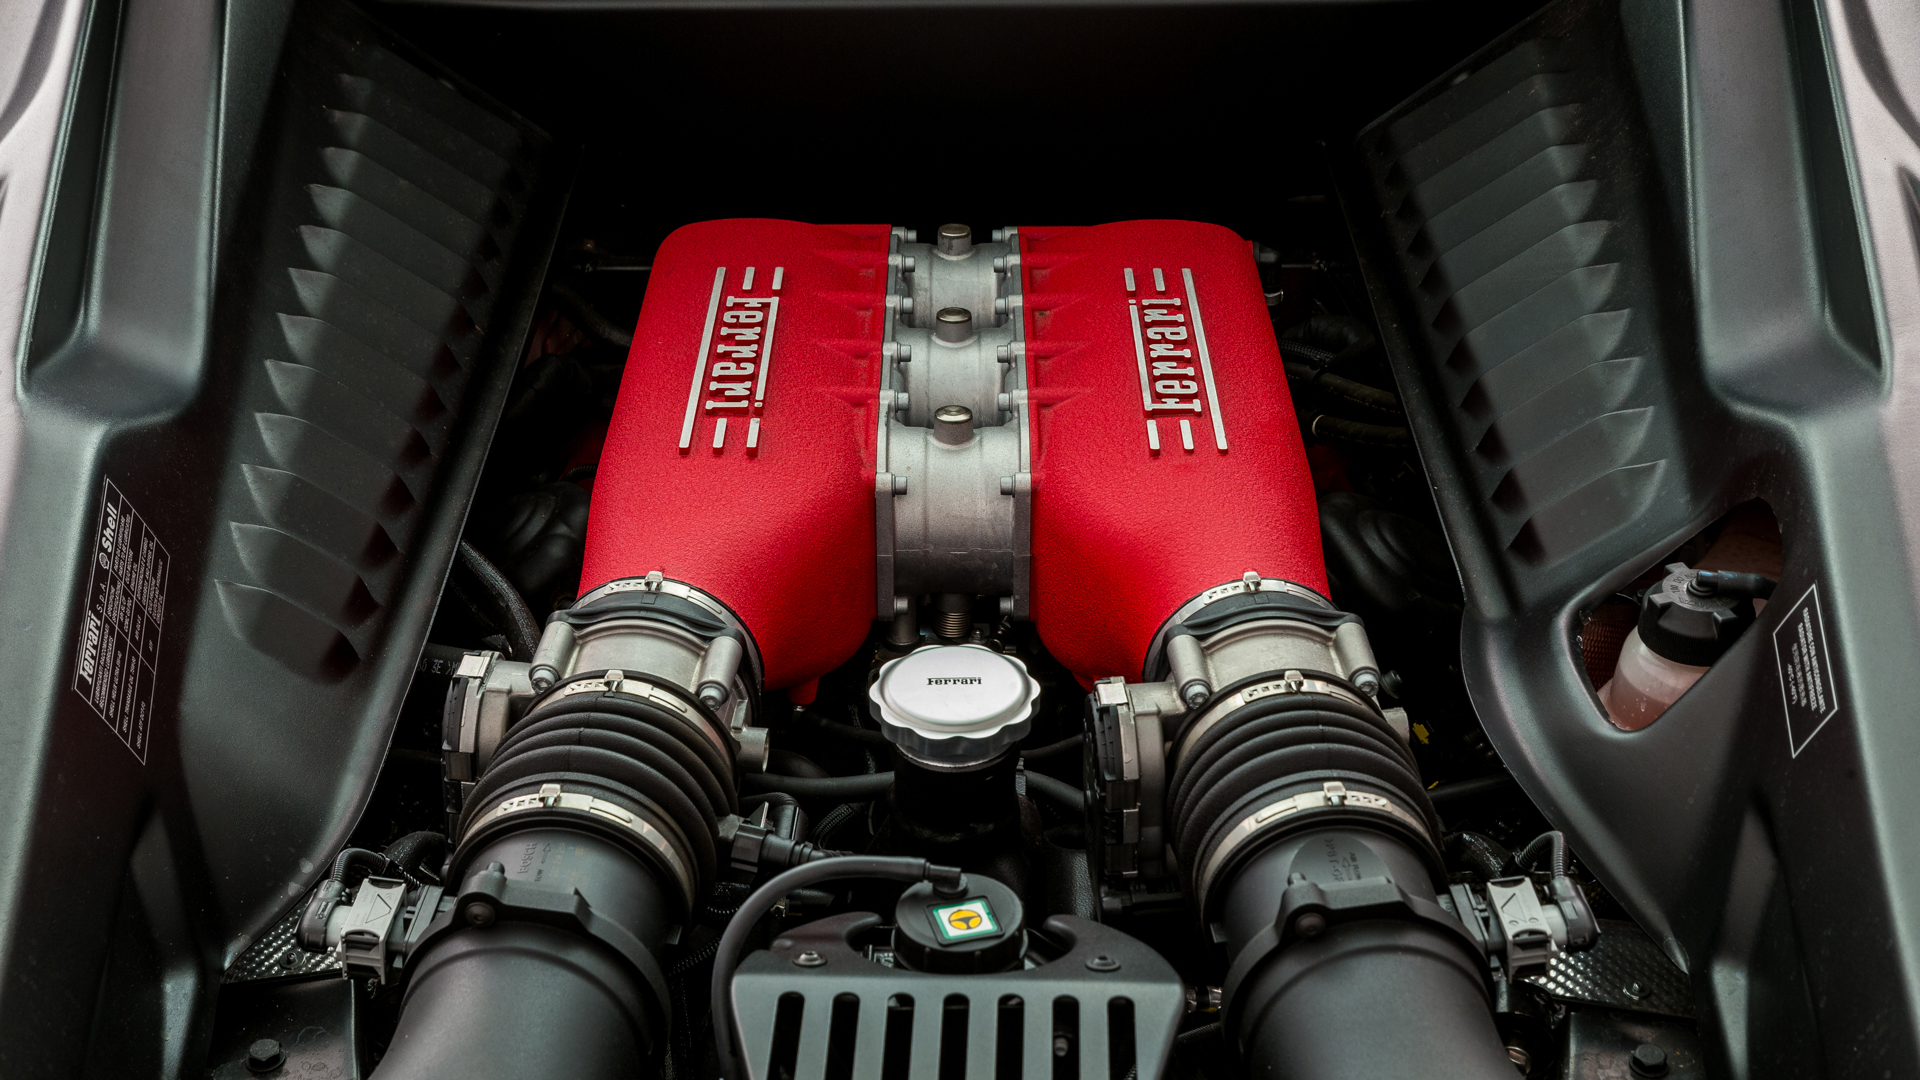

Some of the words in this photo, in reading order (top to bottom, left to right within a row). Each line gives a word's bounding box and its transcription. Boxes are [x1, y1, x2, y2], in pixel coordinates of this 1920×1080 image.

[705, 296, 780, 413] Ferrari
[1128, 298, 1202, 413] Ferrari
[102, 503, 117, 552] Shell
[80, 611, 100, 684] Ferrari
[926, 676, 982, 686] Ferrari
